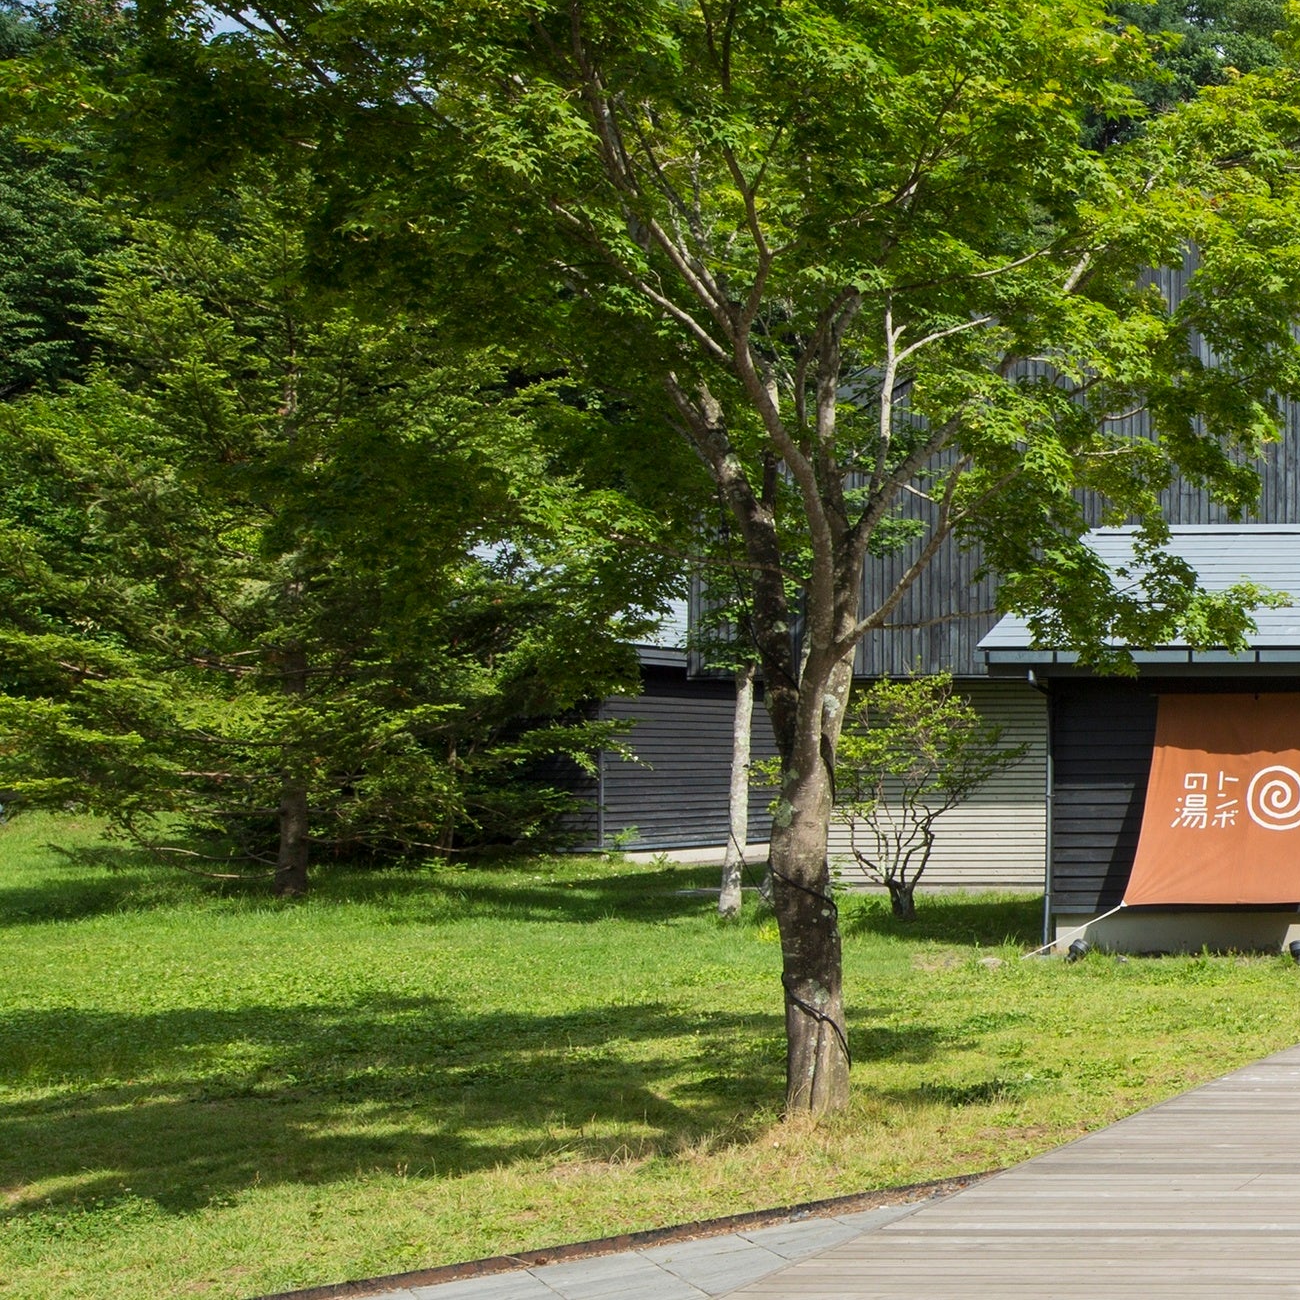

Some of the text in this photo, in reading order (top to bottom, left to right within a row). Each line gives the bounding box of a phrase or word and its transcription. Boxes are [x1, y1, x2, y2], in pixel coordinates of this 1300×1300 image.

[1171, 772, 1208, 829] の湯
[1211, 770, 1239, 828] トンボ
